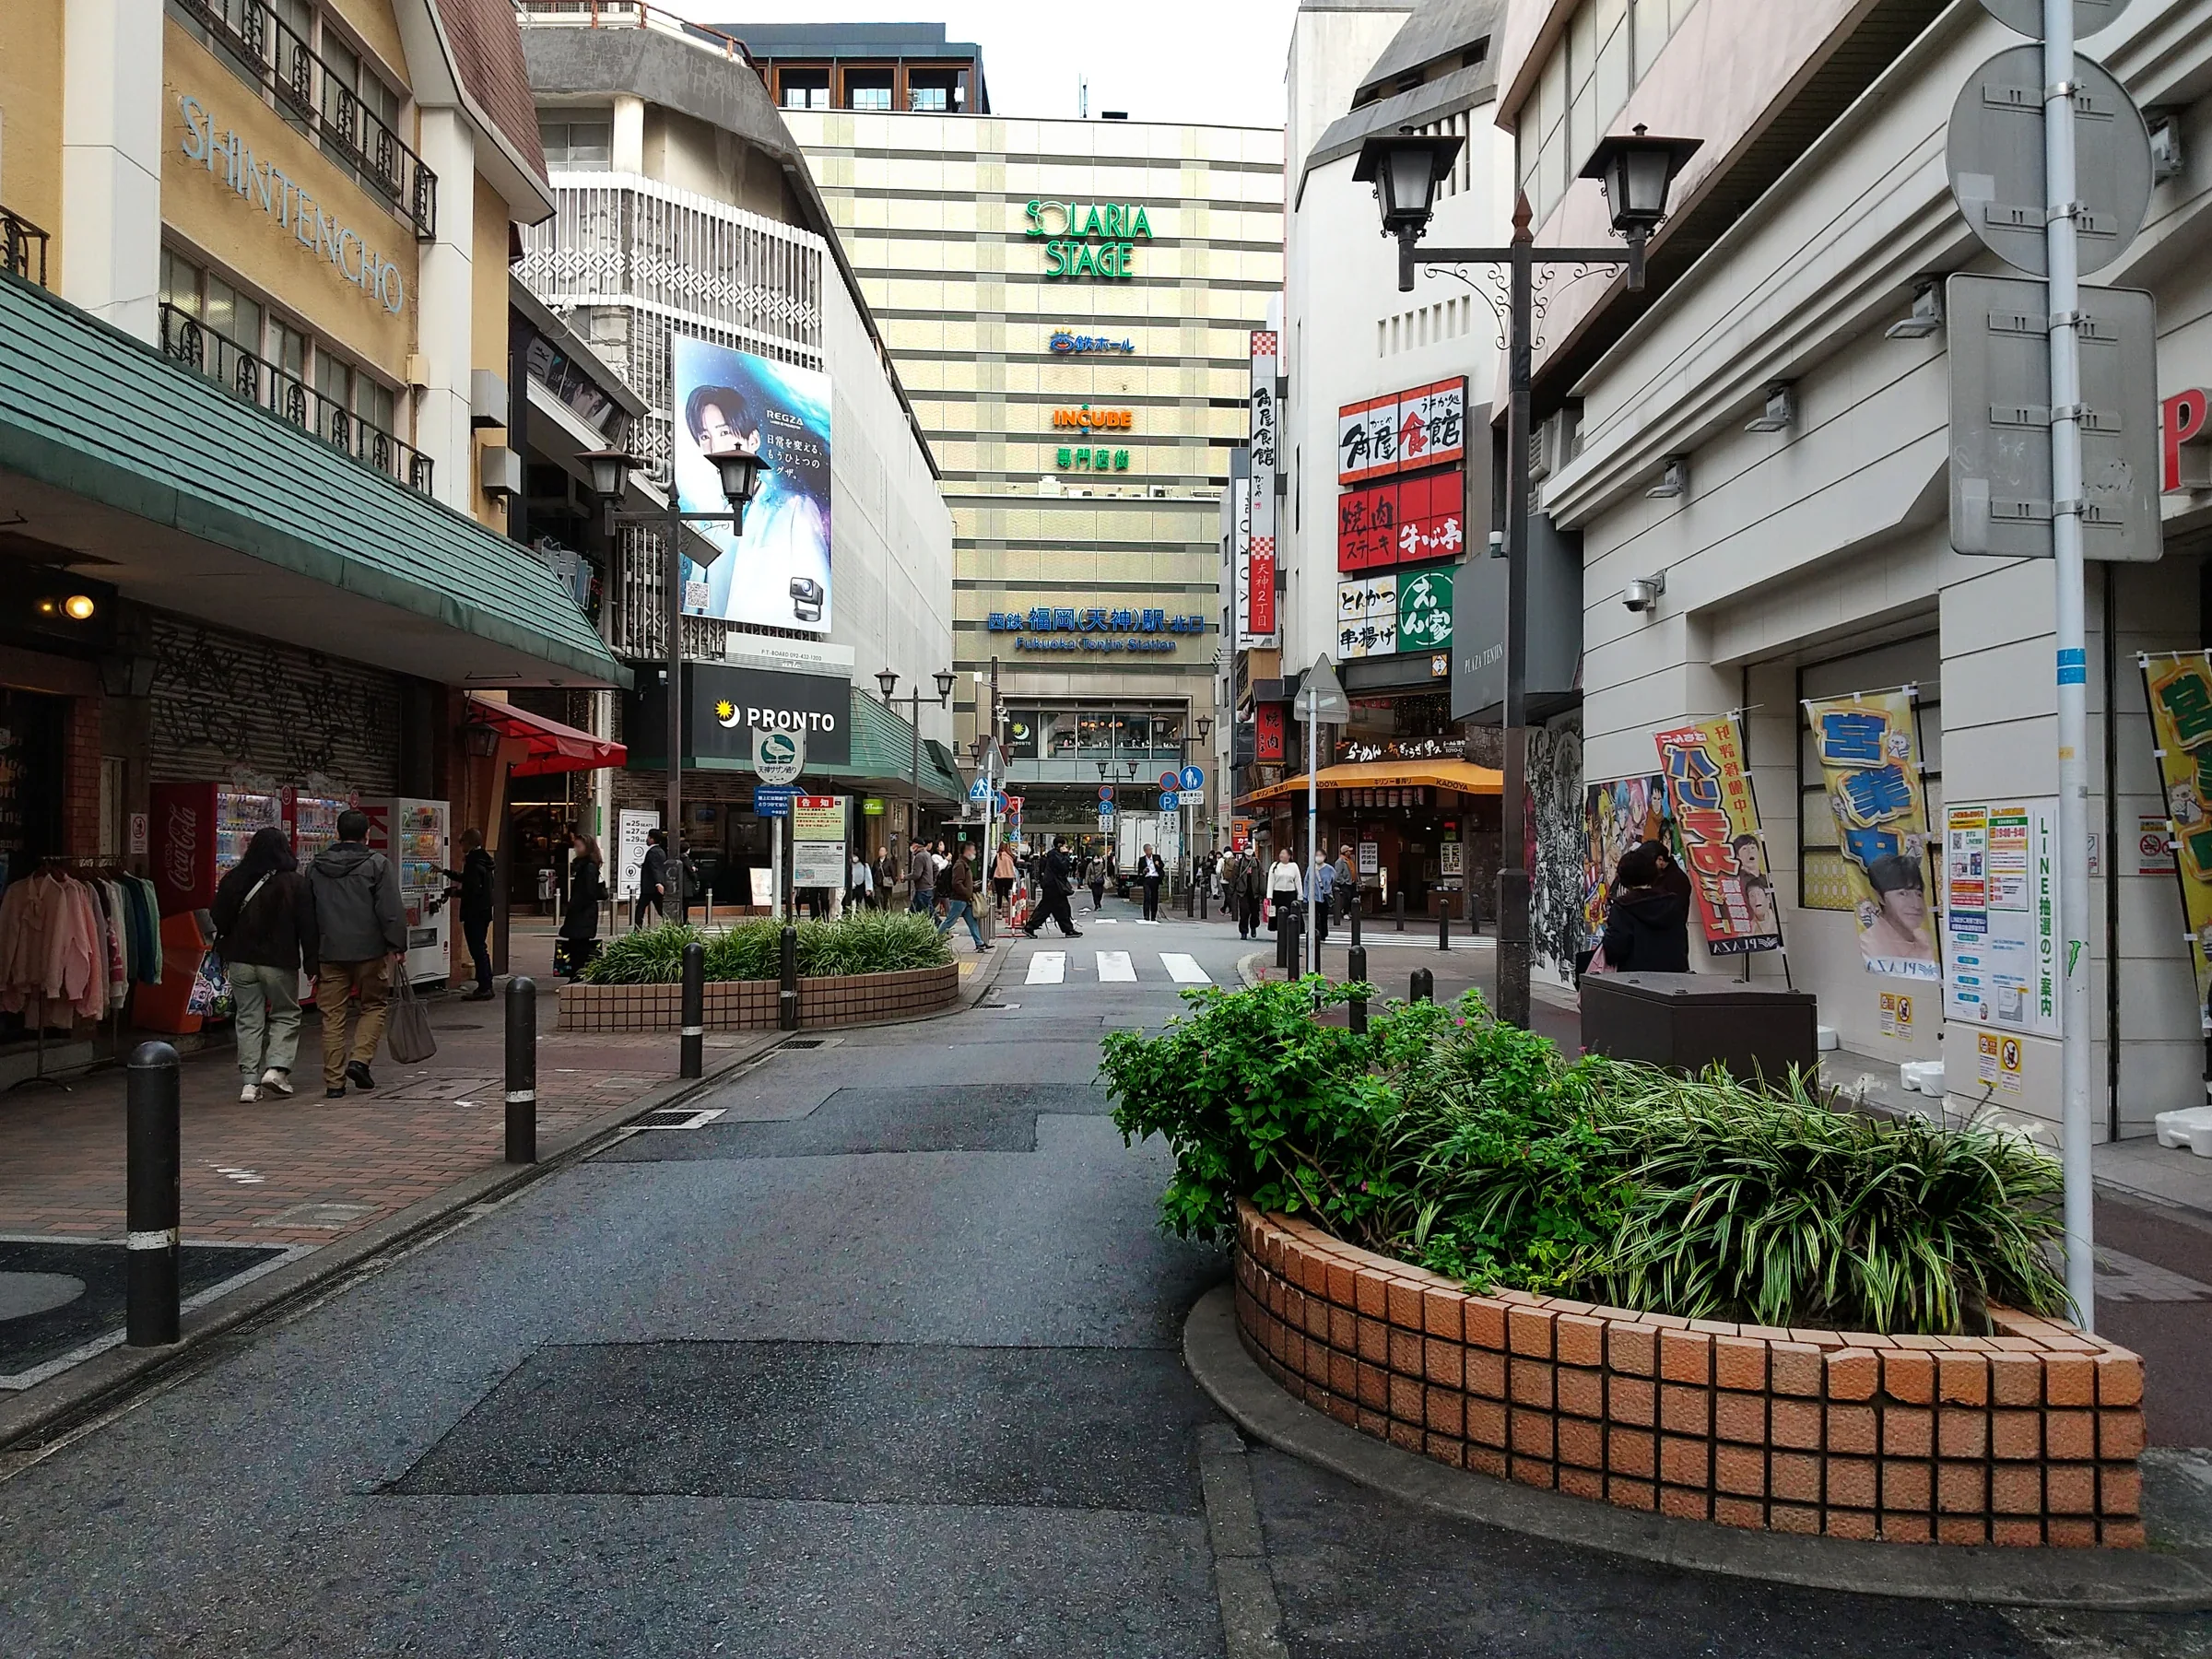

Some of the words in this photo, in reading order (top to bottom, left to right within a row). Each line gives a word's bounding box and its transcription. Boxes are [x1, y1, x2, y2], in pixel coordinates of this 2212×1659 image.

[179, 94, 405, 315] SHINTENCHO
[1026, 200, 1153, 238] SOLARIA
[1046, 241, 1133, 277] STAGE
[766, 409, 804, 426] REGZA
[1053, 409, 1133, 427] INCUBE
[1253, 387, 1275, 467] 角屋食館
[767, 433, 823, 456] 日常を変える、
[1342, 408, 1461, 469] 角屋食館
[768, 449, 820, 468] もうひとつの
[770, 465, 797, 479] グザ。
[1342, 494, 1394, 536] 焼肉
[1347, 535, 1390, 560] ステーキ
[1255, 563, 1269, 628] 天神2丁目
[1341, 589, 1396, 611] とんかつ
[1029, 607, 1165, 632] 福岡(天神)駅
[1015, 637, 1077, 651] Fukuoka
[1127, 638, 1176, 651] Station
[1340, 624, 1397, 652] 串揚げ
[1465, 654, 1482, 674] PLAZA
[1483, 641, 1504, 666] TENJIN
[747, 707, 836, 732] PRONTO
[1265, 712, 1280, 750] 焼肉
[1315, 780, 1339, 788] ADOYA
[1436, 779, 1469, 791] KADOYA
[167, 801, 196, 892] Coca-Cola
